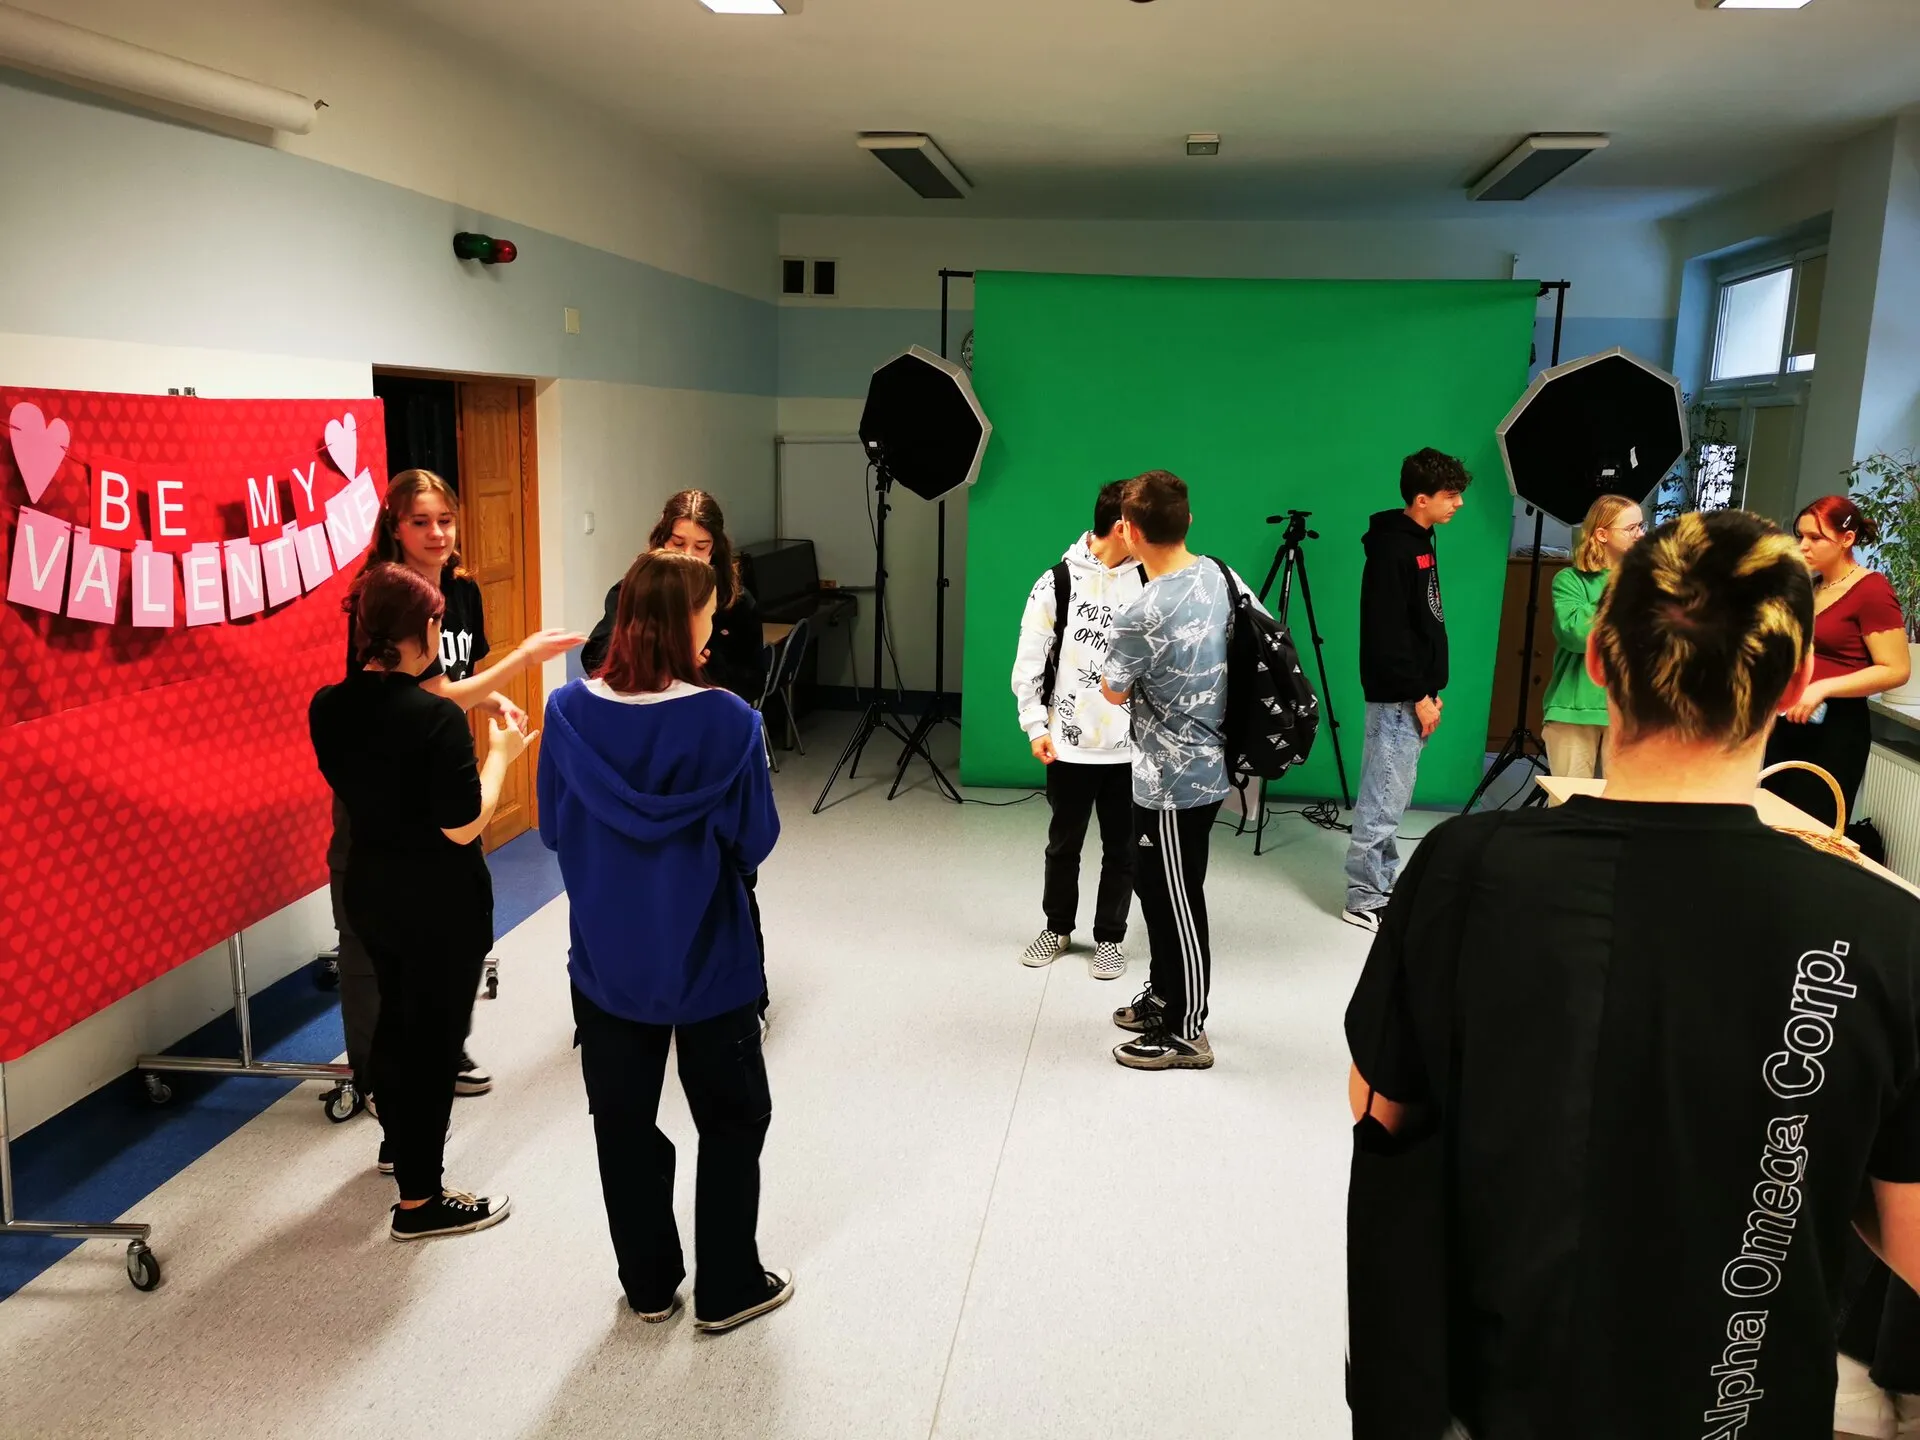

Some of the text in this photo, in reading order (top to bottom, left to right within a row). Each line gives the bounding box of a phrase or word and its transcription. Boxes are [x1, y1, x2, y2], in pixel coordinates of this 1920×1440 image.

[24, 481, 381, 613] VALENTINE
[100, 460, 317, 537] BE MY
[1762, 940, 1858, 1100] Corp.
[1722, 1113, 1809, 1299] Omega
